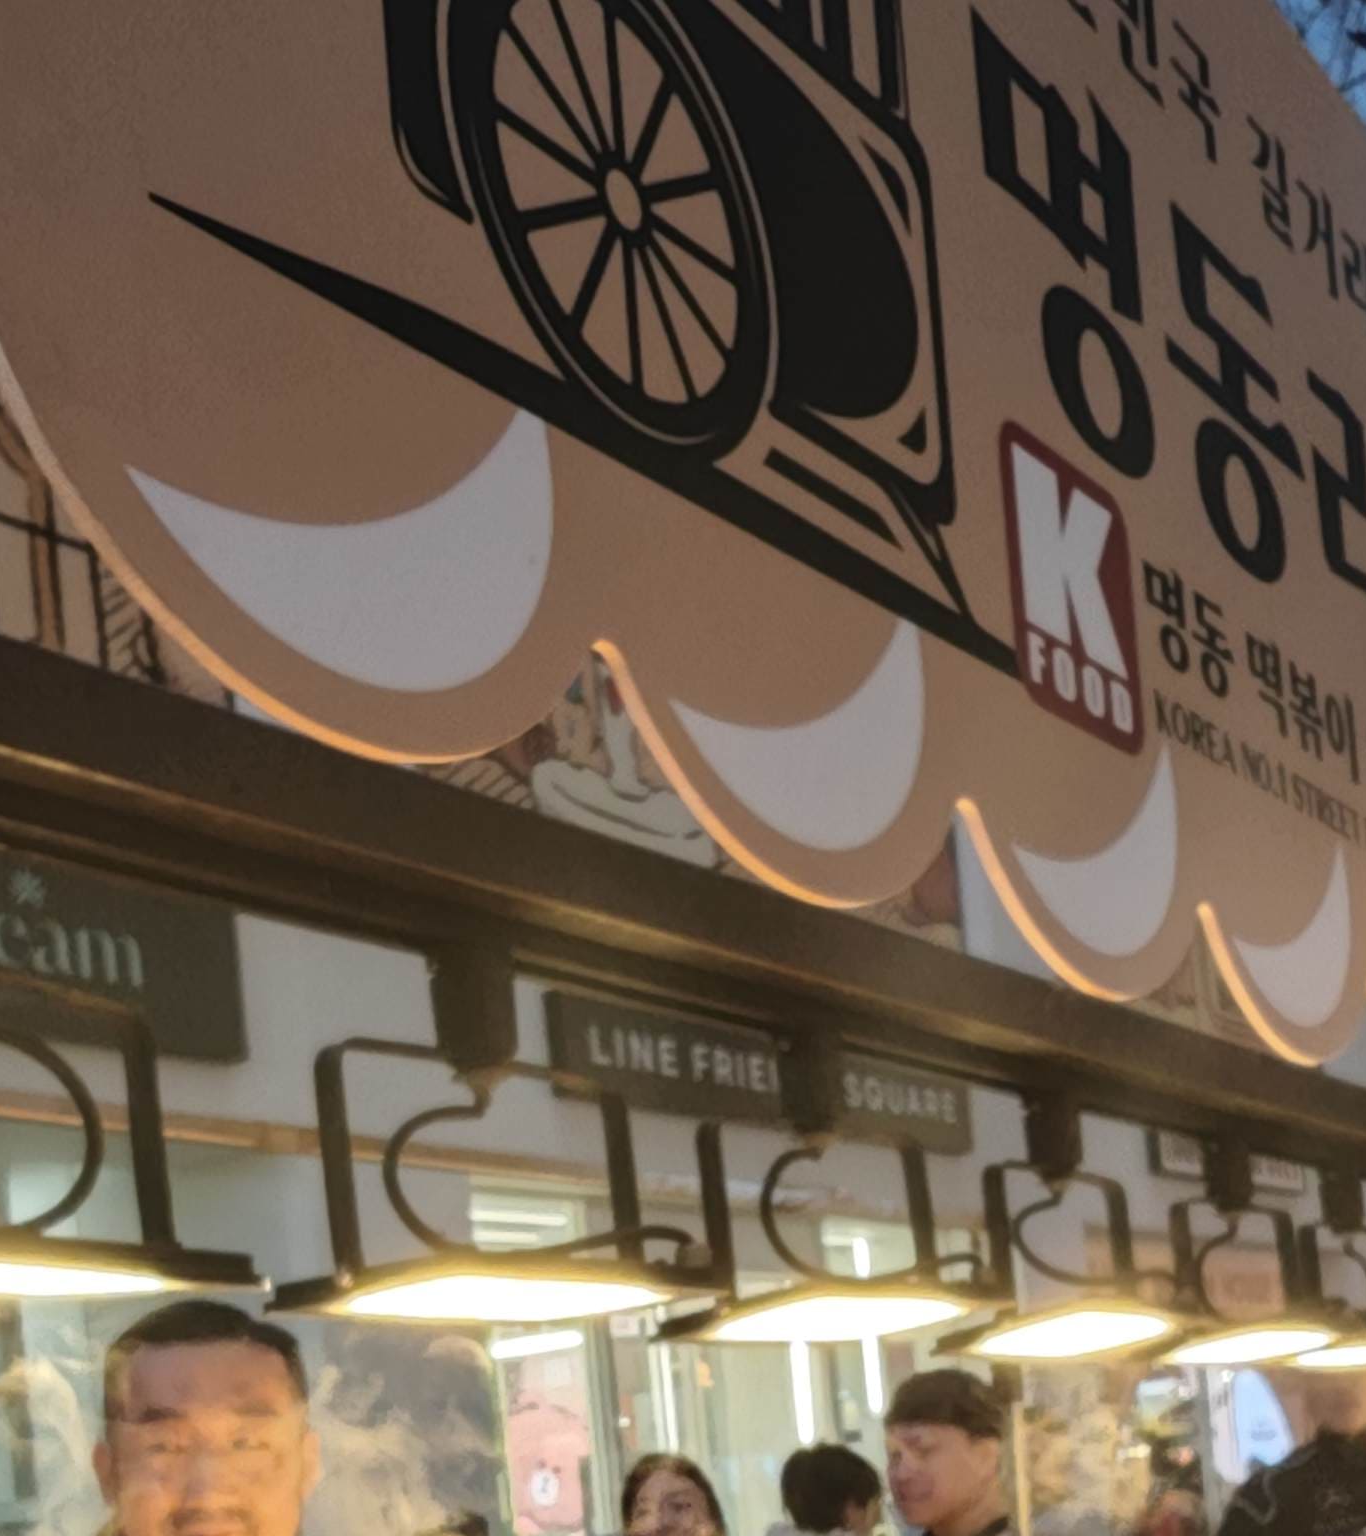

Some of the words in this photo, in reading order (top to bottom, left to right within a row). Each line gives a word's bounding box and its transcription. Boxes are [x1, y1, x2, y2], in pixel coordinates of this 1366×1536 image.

[1011, 441, 1128, 682] K
[1027, 624, 1137, 736] FOOD
[1140, 558, 1235, 700] 명동
[1245, 630, 1361, 786] 떡볶이
[1152, 688, 1237, 776] KOREA
[1291, 771, 1362, 846] STREET
[586, 1023, 680, 1080] LINE
[842, 1070, 959, 1125] SQUARE
